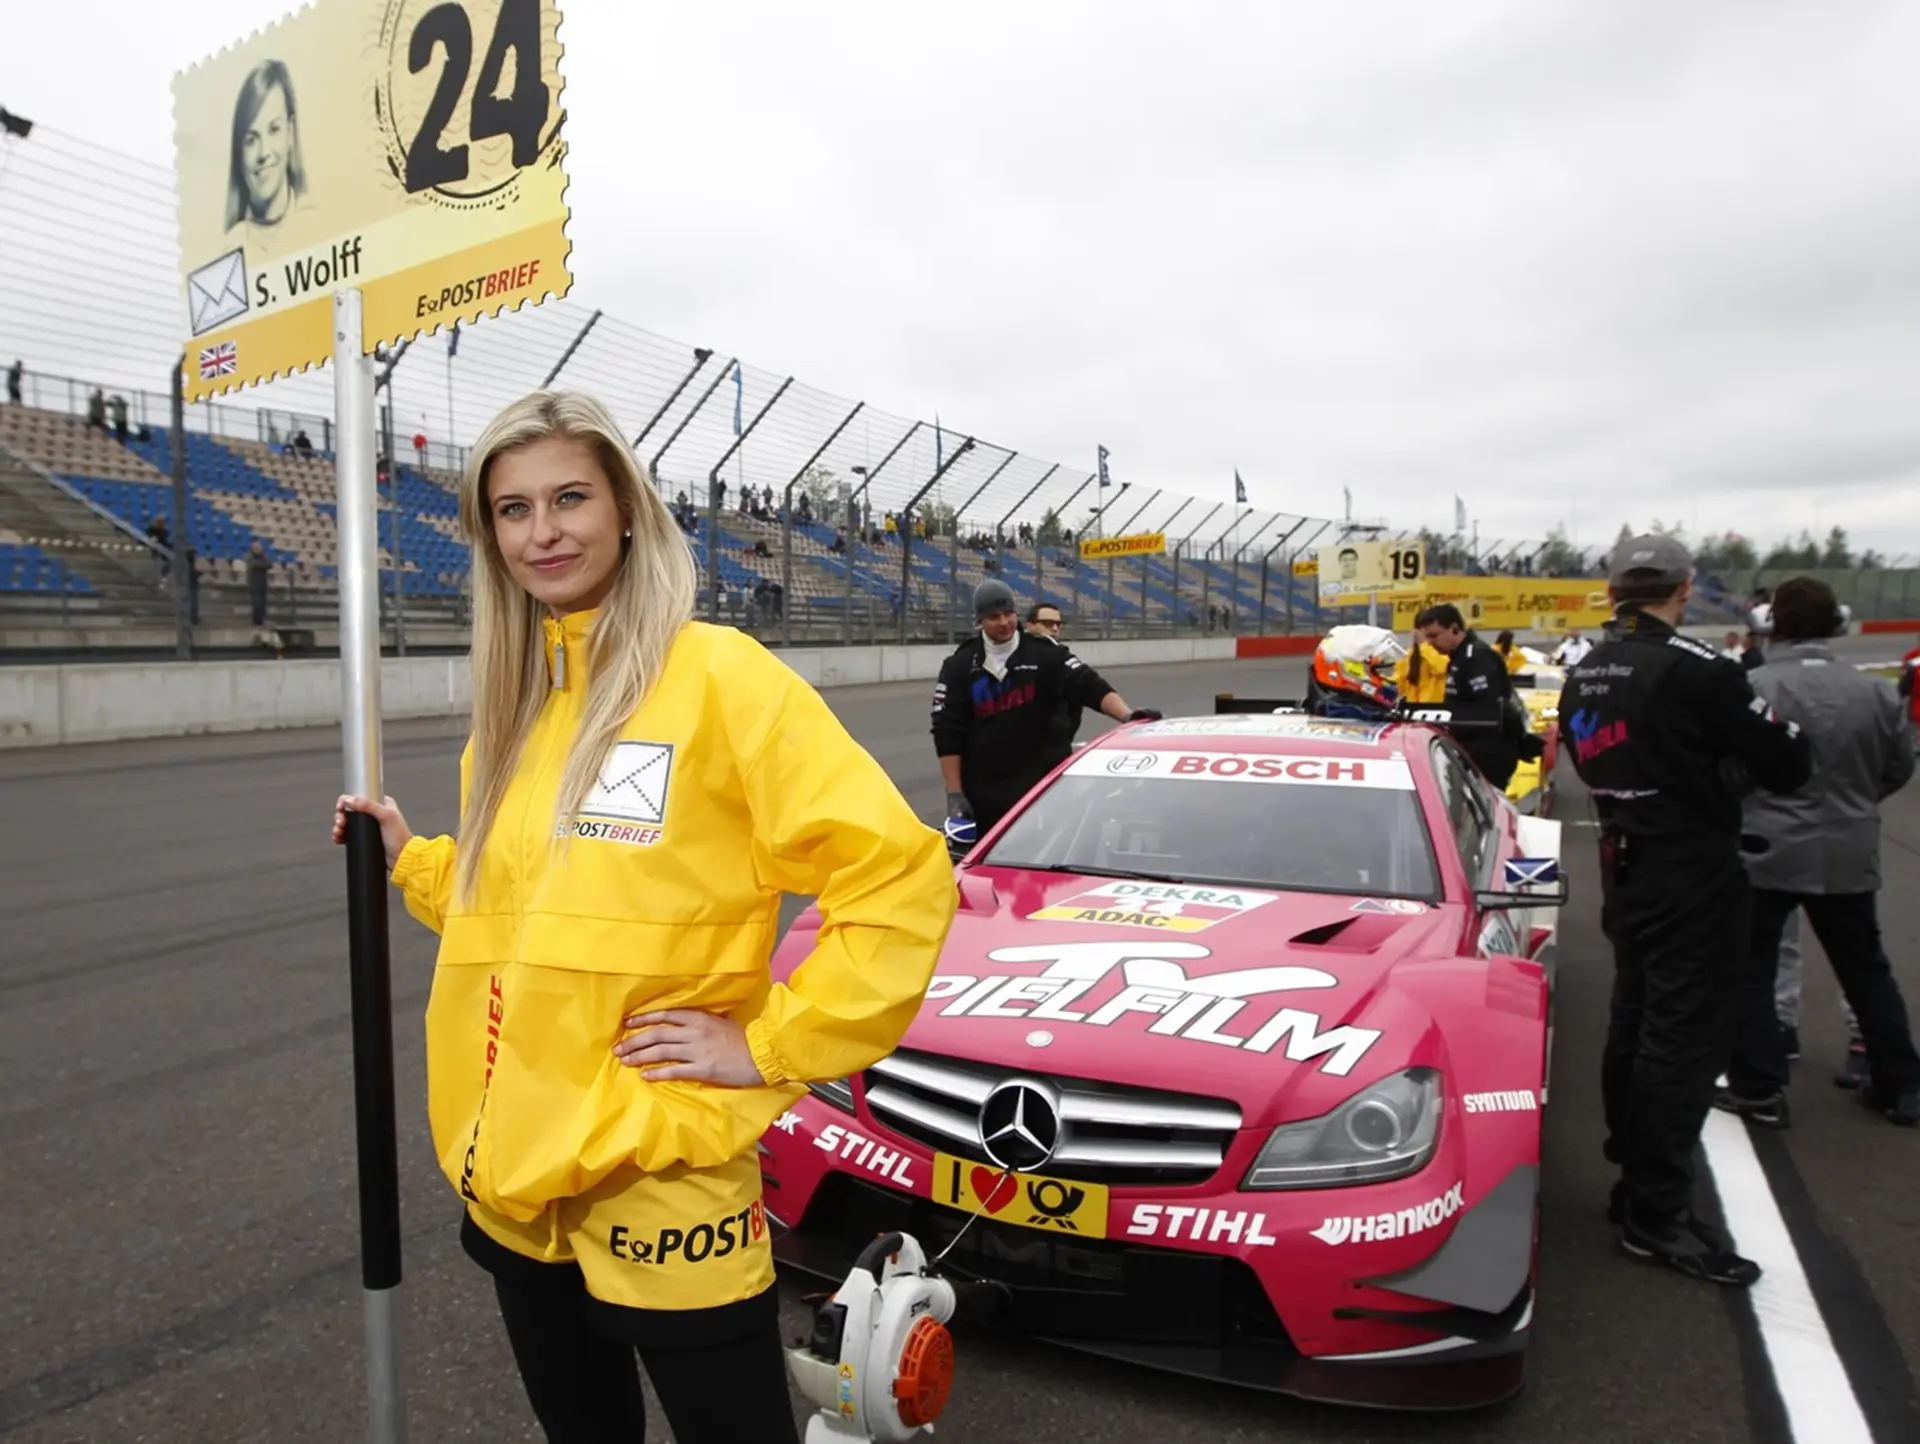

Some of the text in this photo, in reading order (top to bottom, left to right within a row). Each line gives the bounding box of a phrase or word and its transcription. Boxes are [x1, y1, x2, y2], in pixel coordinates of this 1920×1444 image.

[406, 0, 549, 193] 24
[256, 235, 362, 307] S. Wolff
[1389, 550, 1420, 580] 19
[1171, 755, 1365, 782] BOSCH
[1112, 883, 1244, 906] DEKRA
[1073, 909, 1170, 928] ADAC
[925, 975, 1385, 1077] PIELFILM
[1463, 1090, 1537, 1113] SYNTIUM
[813, 1123, 914, 1188] STIHL
[1127, 1204, 1276, 1246] STIHL
